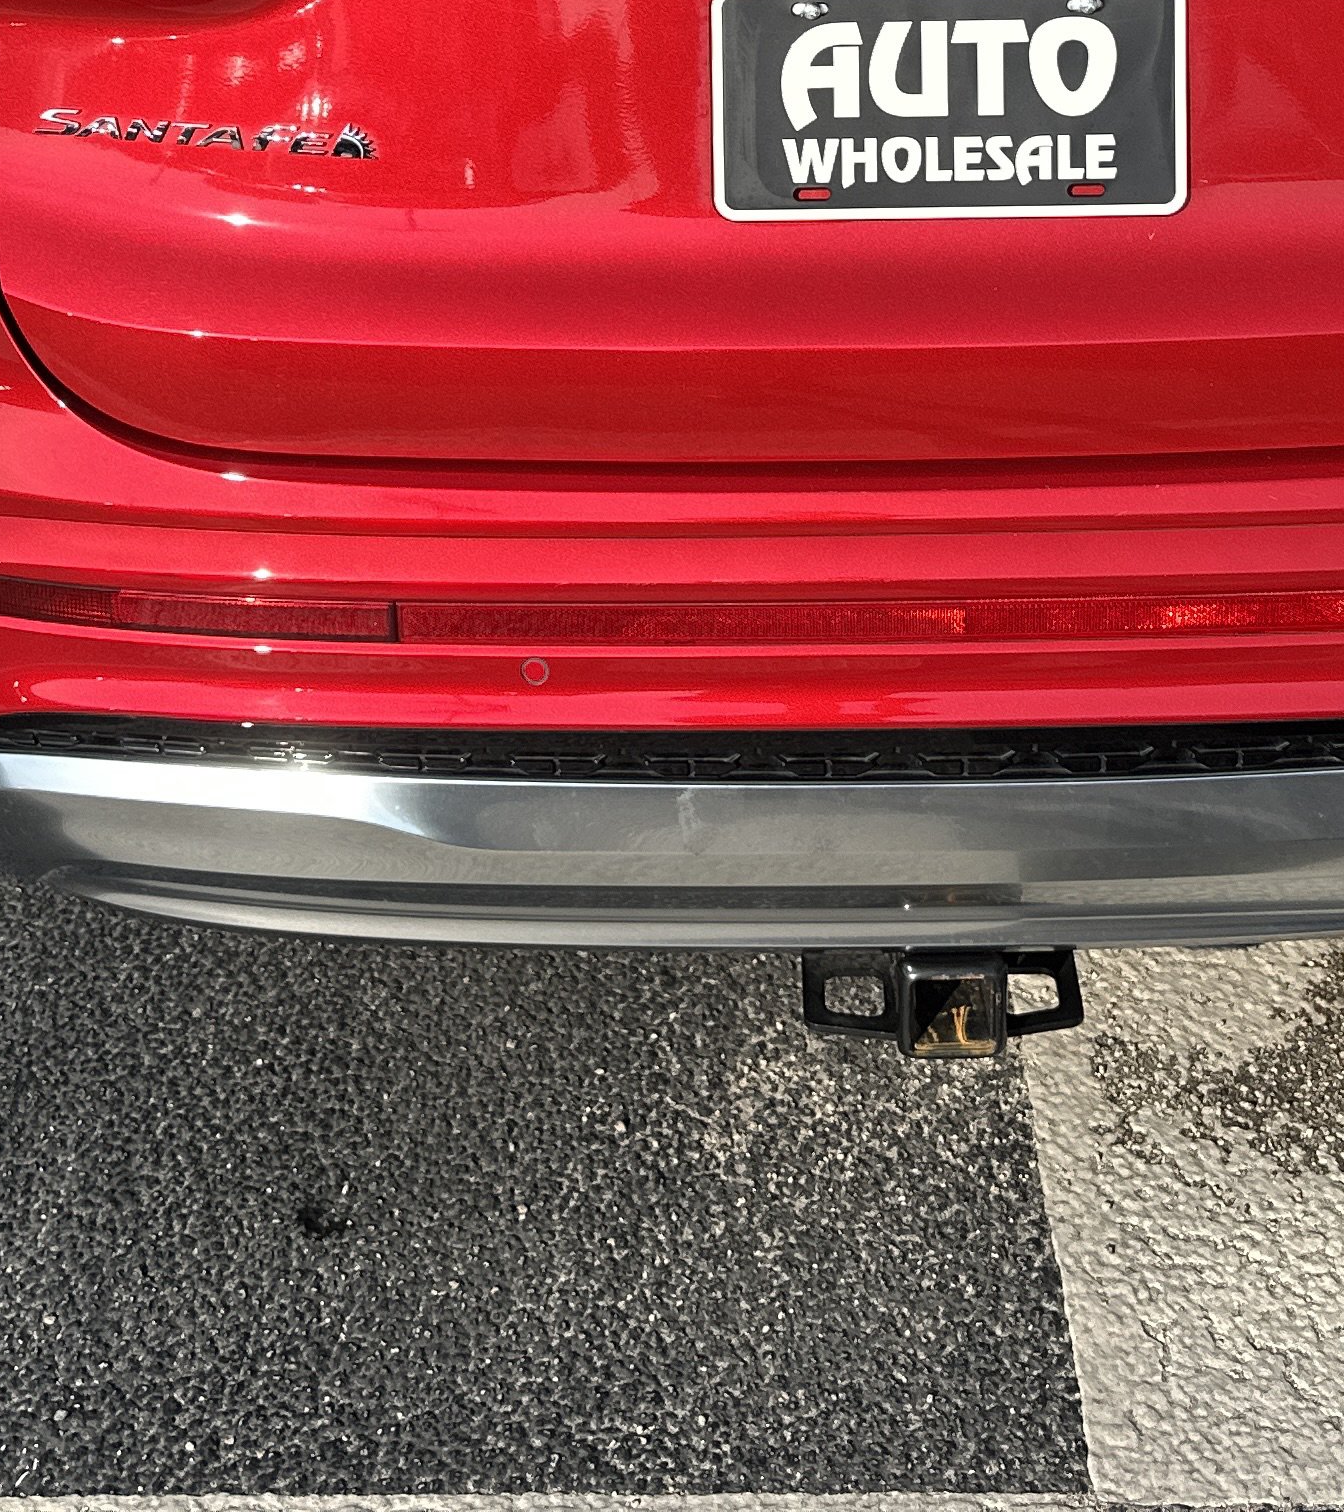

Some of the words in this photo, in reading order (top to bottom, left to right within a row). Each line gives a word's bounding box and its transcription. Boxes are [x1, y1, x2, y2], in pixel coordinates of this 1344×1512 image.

[780, 15, 1118, 132] AUTO
[32, 107, 246, 152] SANTA
[781, 133, 1118, 190] WHOLESALE
